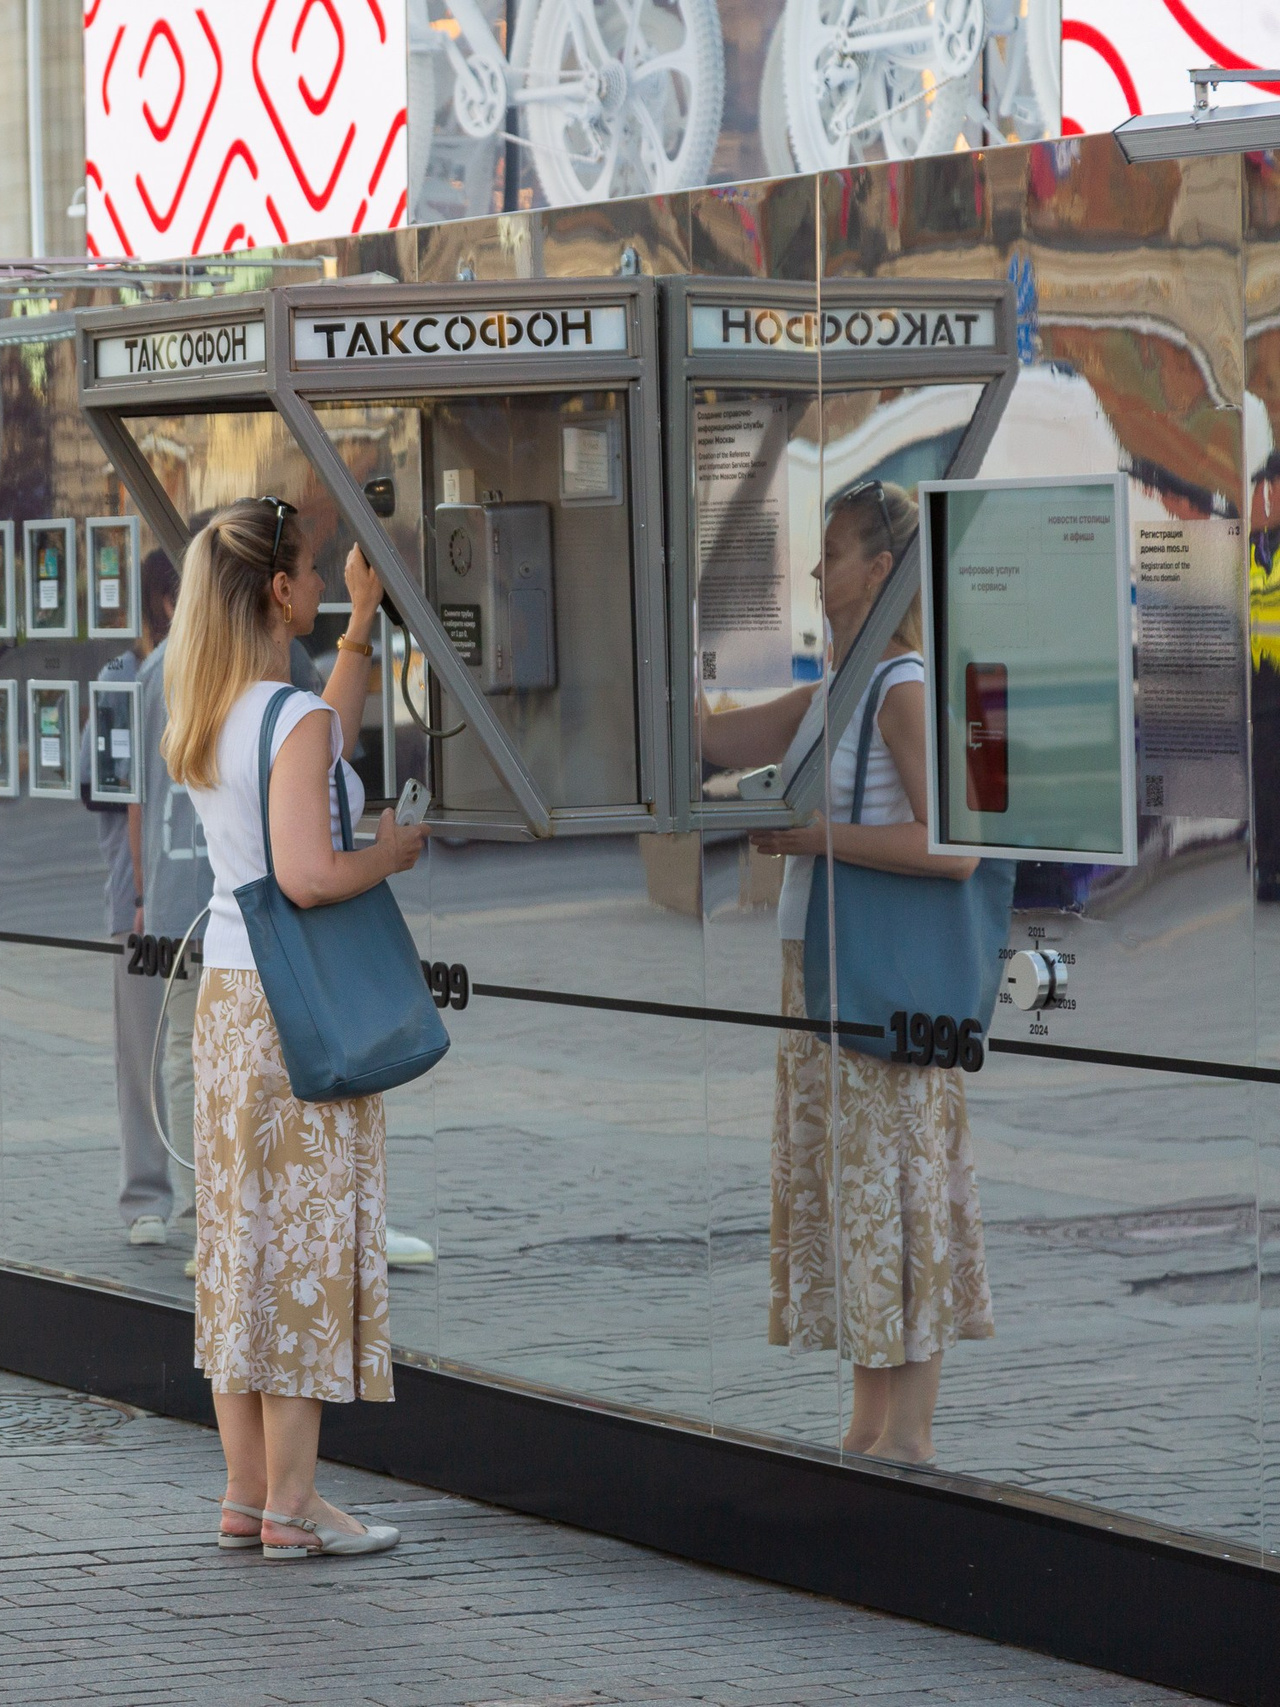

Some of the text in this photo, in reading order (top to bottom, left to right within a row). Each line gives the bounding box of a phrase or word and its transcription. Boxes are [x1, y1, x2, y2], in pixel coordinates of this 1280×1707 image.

[314, 310, 593, 358] ТАКСОФОН
[124, 325, 247, 373] ТАКСОФОН
[1048, 515, 1111, 525] новости столицы
[1063, 531, 1095, 544] и афиша
[1140, 529, 1183, 540] Регистрация
[1140, 545, 1190, 555] домена mos.ru
[959, 565, 1020, 578] цифровые услуги
[1140, 561, 1191, 571] Registration of the
[1160, 573, 1181, 581] domain
[978, 582, 1007, 593] сервисы
[1028, 926, 1046, 938] 2011
[1057, 952, 1076, 965] 2015
[1058, 999, 1077, 1011] 2019
[1029, 1024, 1049, 1036] 2024
[890, 1010, 985, 1073] 1996
